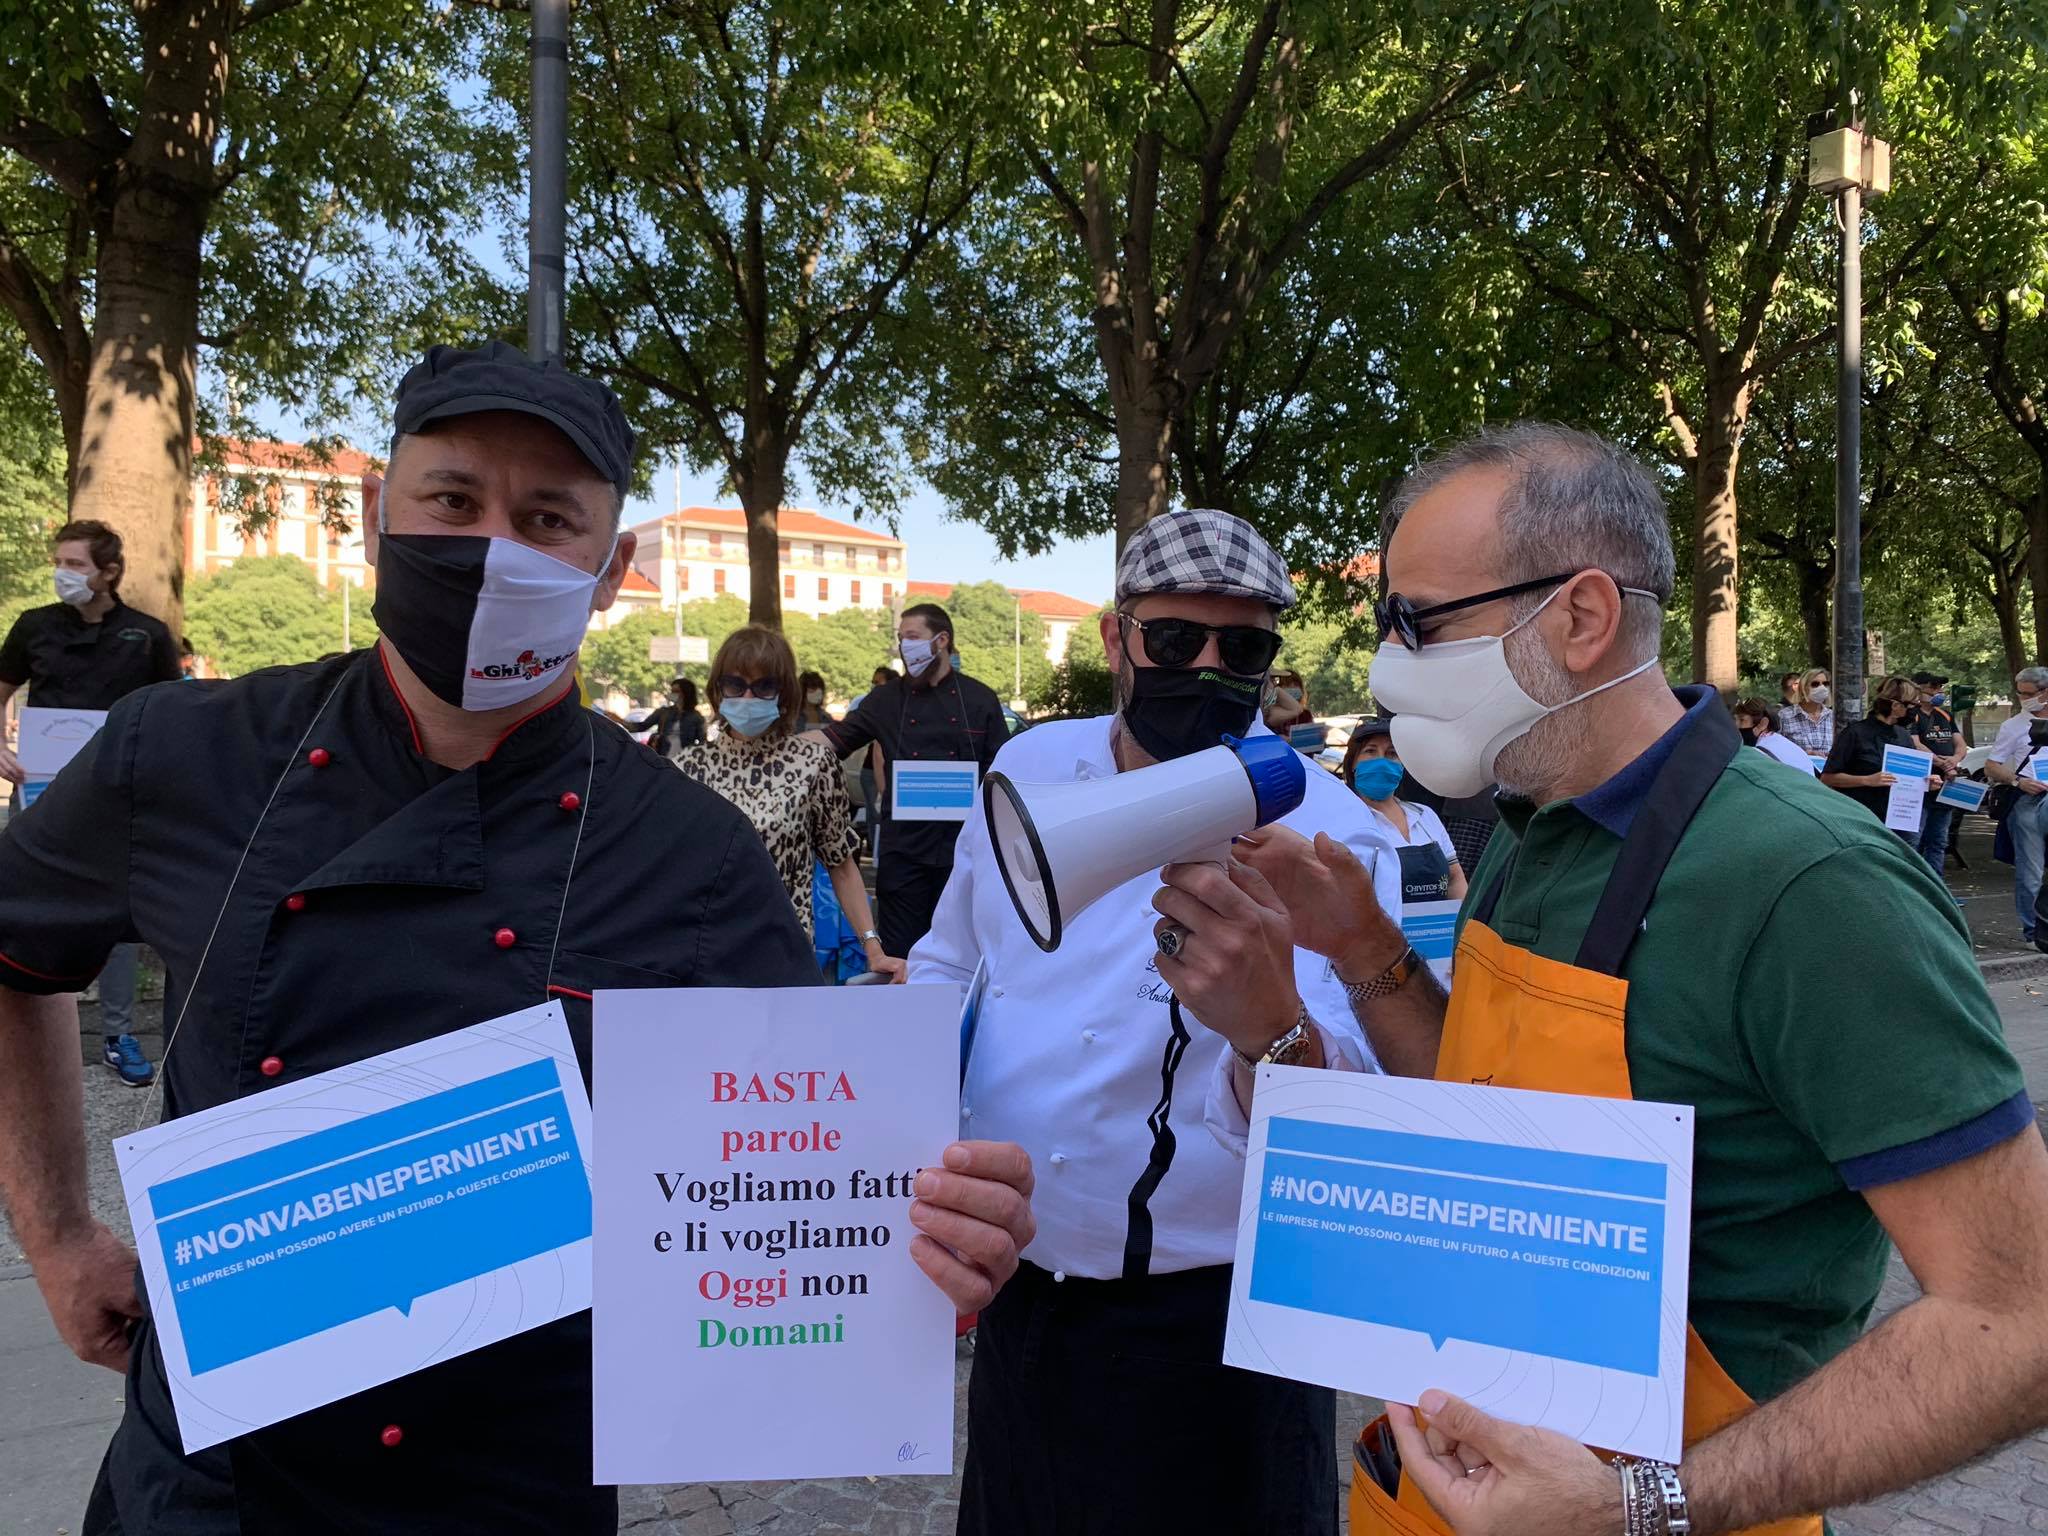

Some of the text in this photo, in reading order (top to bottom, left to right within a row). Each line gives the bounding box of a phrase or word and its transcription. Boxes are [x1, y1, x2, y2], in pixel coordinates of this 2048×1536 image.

[1136, 982, 1174, 1004] Andr
[711, 1070, 858, 1103] BASTA
[720, 1121, 841, 1162] parole
[175, 1116, 560, 1266] #NONVABENEPERNIENTE
[653, 1168, 922, 1211] Vogliamo fatt
[176, 1151, 570, 1292] LE IMPRESE NON POSSONO AVERE UN FUTURO A QUESTE CONDIZIONI
[1269, 1174, 1648, 1254] #NONVABENEPERNIENTE
[653, 1219, 891, 1259] e li vogliamo
[1263, 1211, 1650, 1281] LE IMPRESE NON POSSONO AVERE UN FUTURO A QUESTE CONDIZIONI
[698, 1268, 869, 1308] Oggi non
[697, 1313, 847, 1348] Domani
